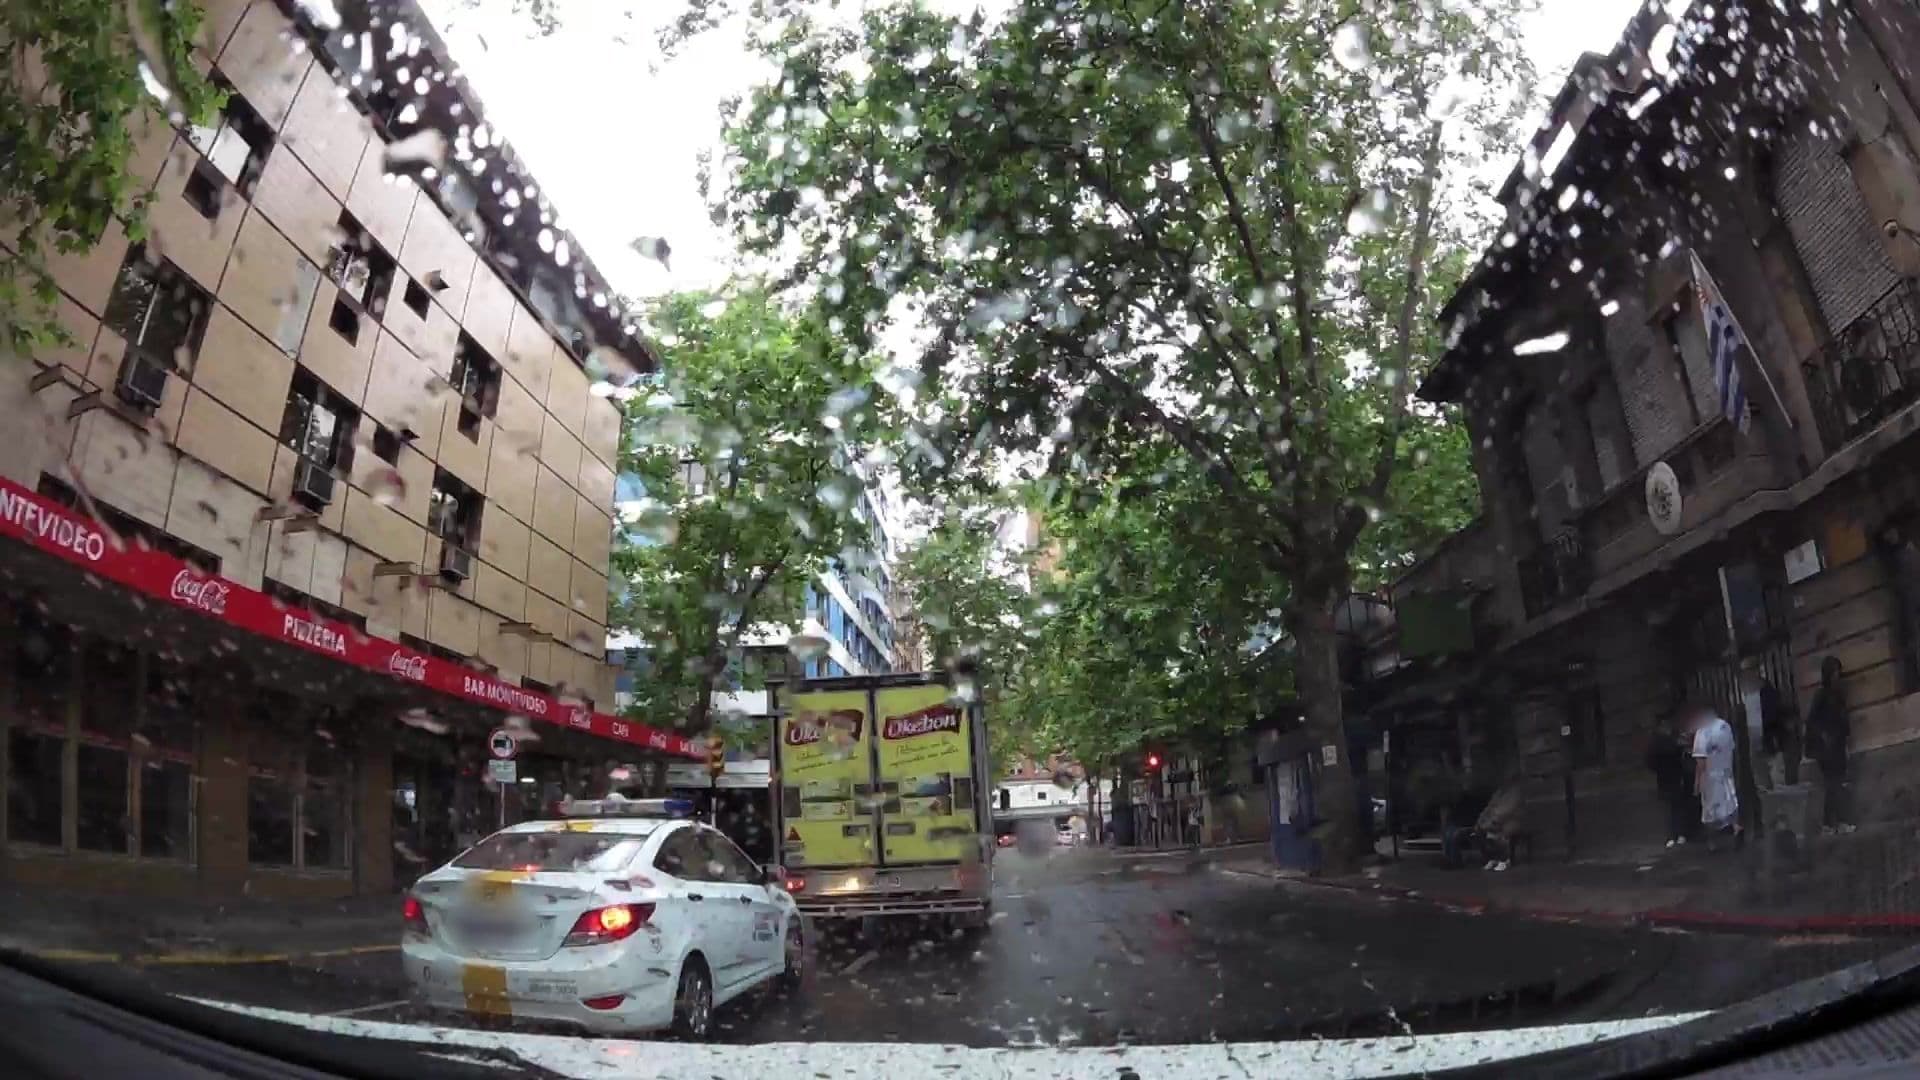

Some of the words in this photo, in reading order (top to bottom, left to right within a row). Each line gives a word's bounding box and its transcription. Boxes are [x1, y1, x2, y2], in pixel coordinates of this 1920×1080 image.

[284, 613, 346, 656] PIZZERIA
[464, 676, 486, 697] BAR
[487, 683, 547, 714] MONTEVIDEO
